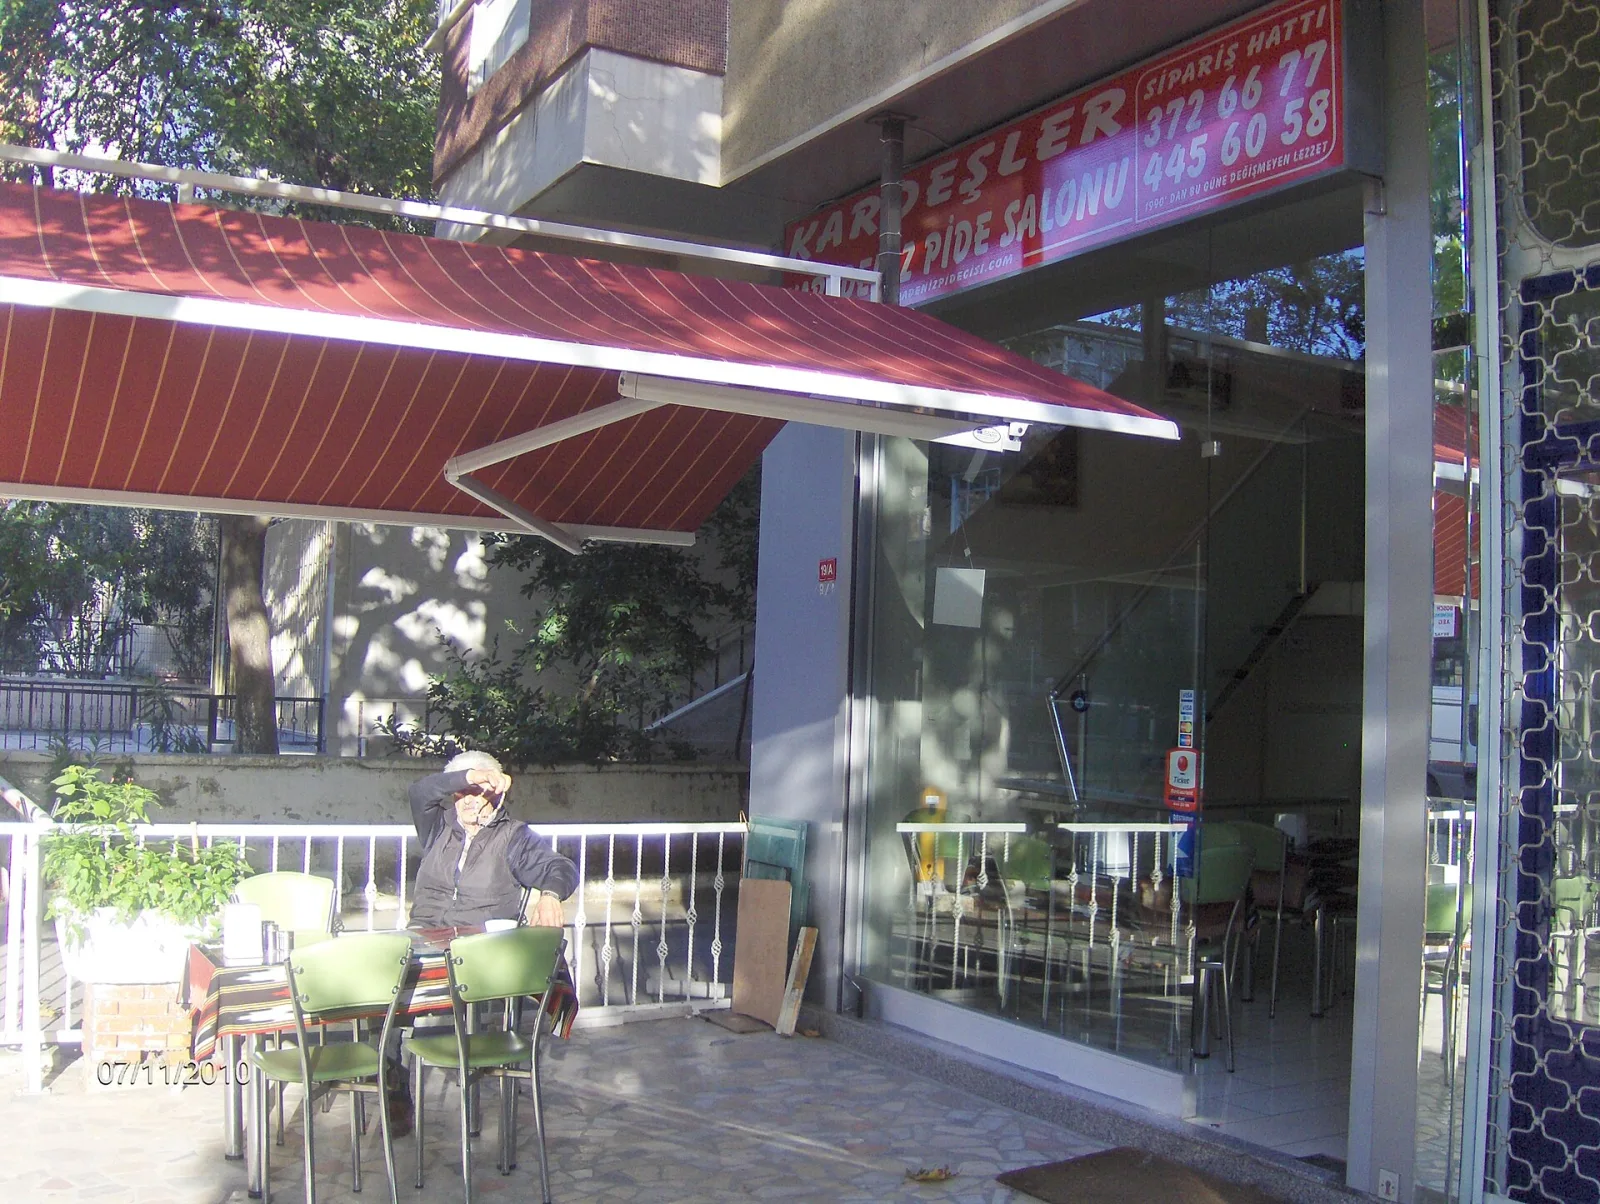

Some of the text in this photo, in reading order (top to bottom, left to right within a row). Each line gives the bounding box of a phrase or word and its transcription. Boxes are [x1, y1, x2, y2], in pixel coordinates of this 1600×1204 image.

[1143, 5, 1327, 100] SİPARİŞ HATTI
[1143, 39, 1328, 148] 372 66 77
[789, 88, 1127, 259] KARDEŞLER
[1143, 89, 1330, 193] 445 60 58
[1170, 188, 1187, 204] DAN
[1190, 184, 1201, 197] BU
[1203, 175, 1227, 192] GÜNE
[1230, 152, 1290, 183] DEĞİŞMEYEN
[1294, 140, 1329, 162] LEZZET
[923, 210, 993, 275] PİDE
[1000, 156, 1129, 248] SALONU
